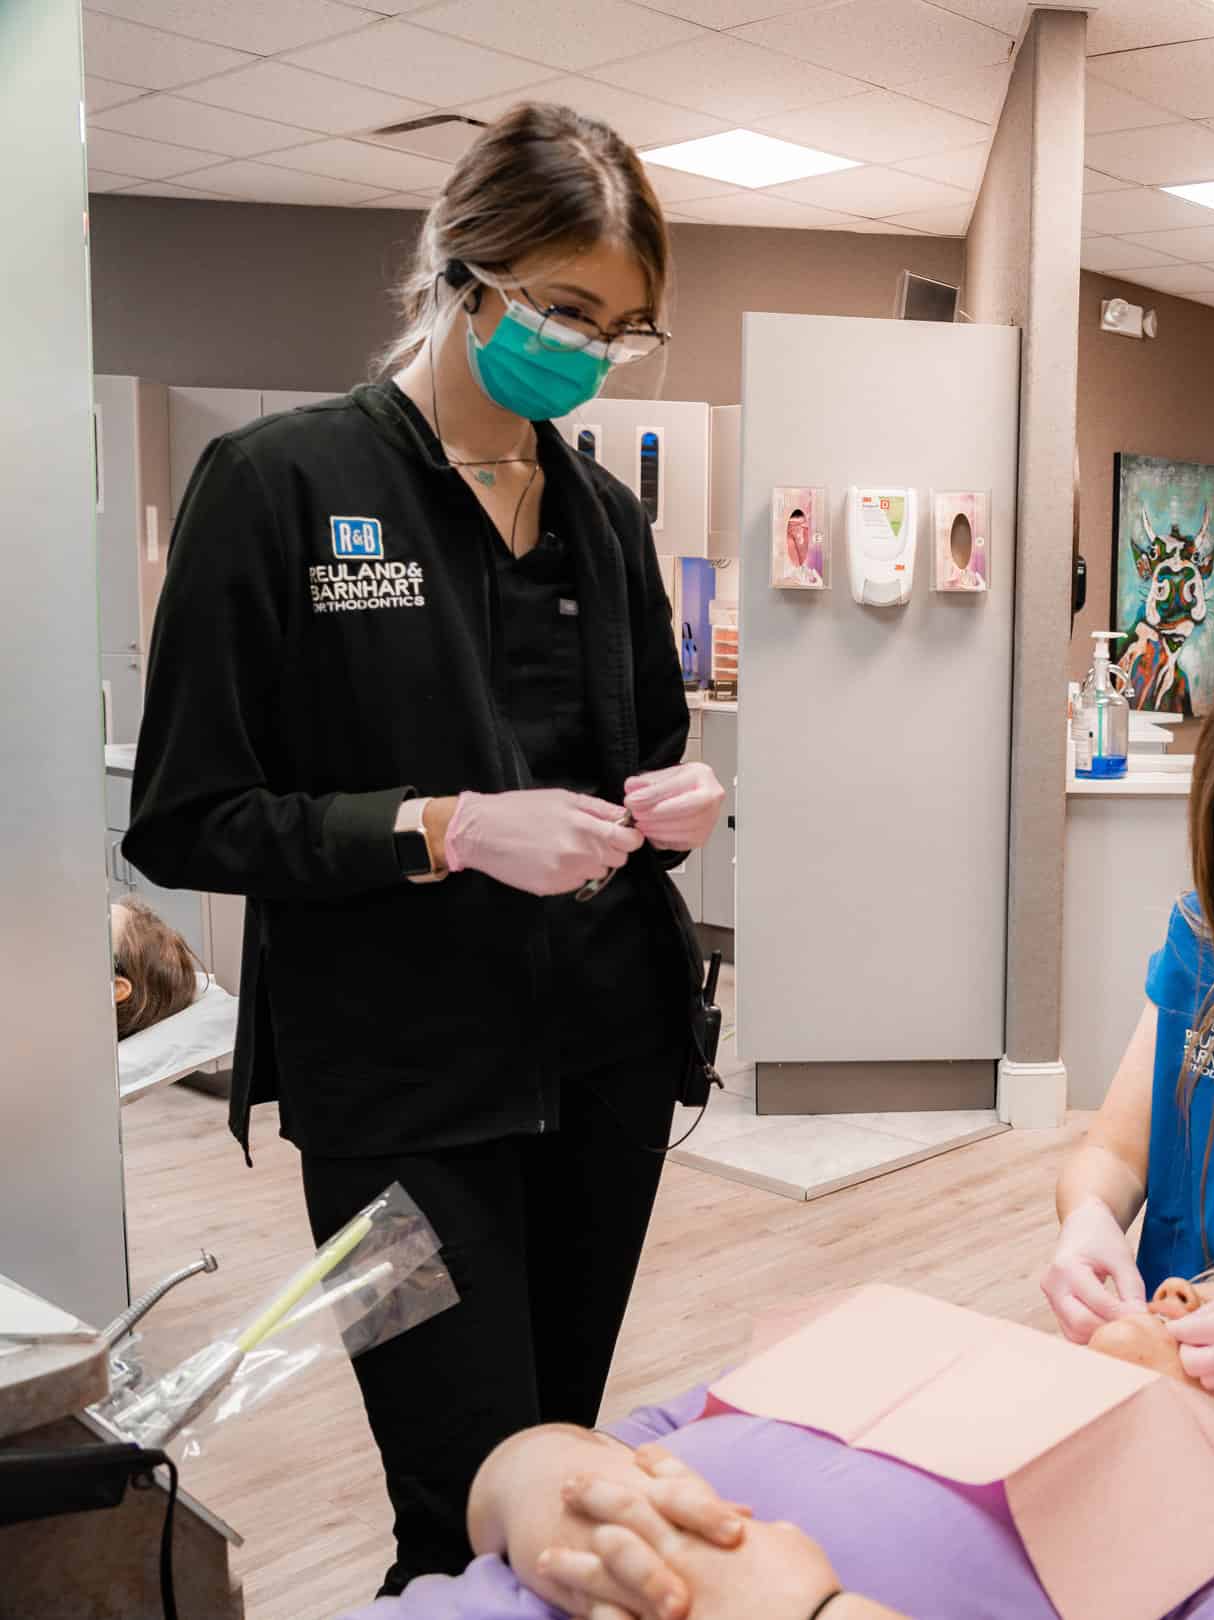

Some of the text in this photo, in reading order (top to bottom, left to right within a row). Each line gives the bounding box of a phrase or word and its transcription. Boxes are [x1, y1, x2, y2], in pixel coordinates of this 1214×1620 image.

[338, 522, 376, 553] R&B
[310, 577, 425, 602] BARNHART
[313, 595, 426, 614] ORTHODONTICS
